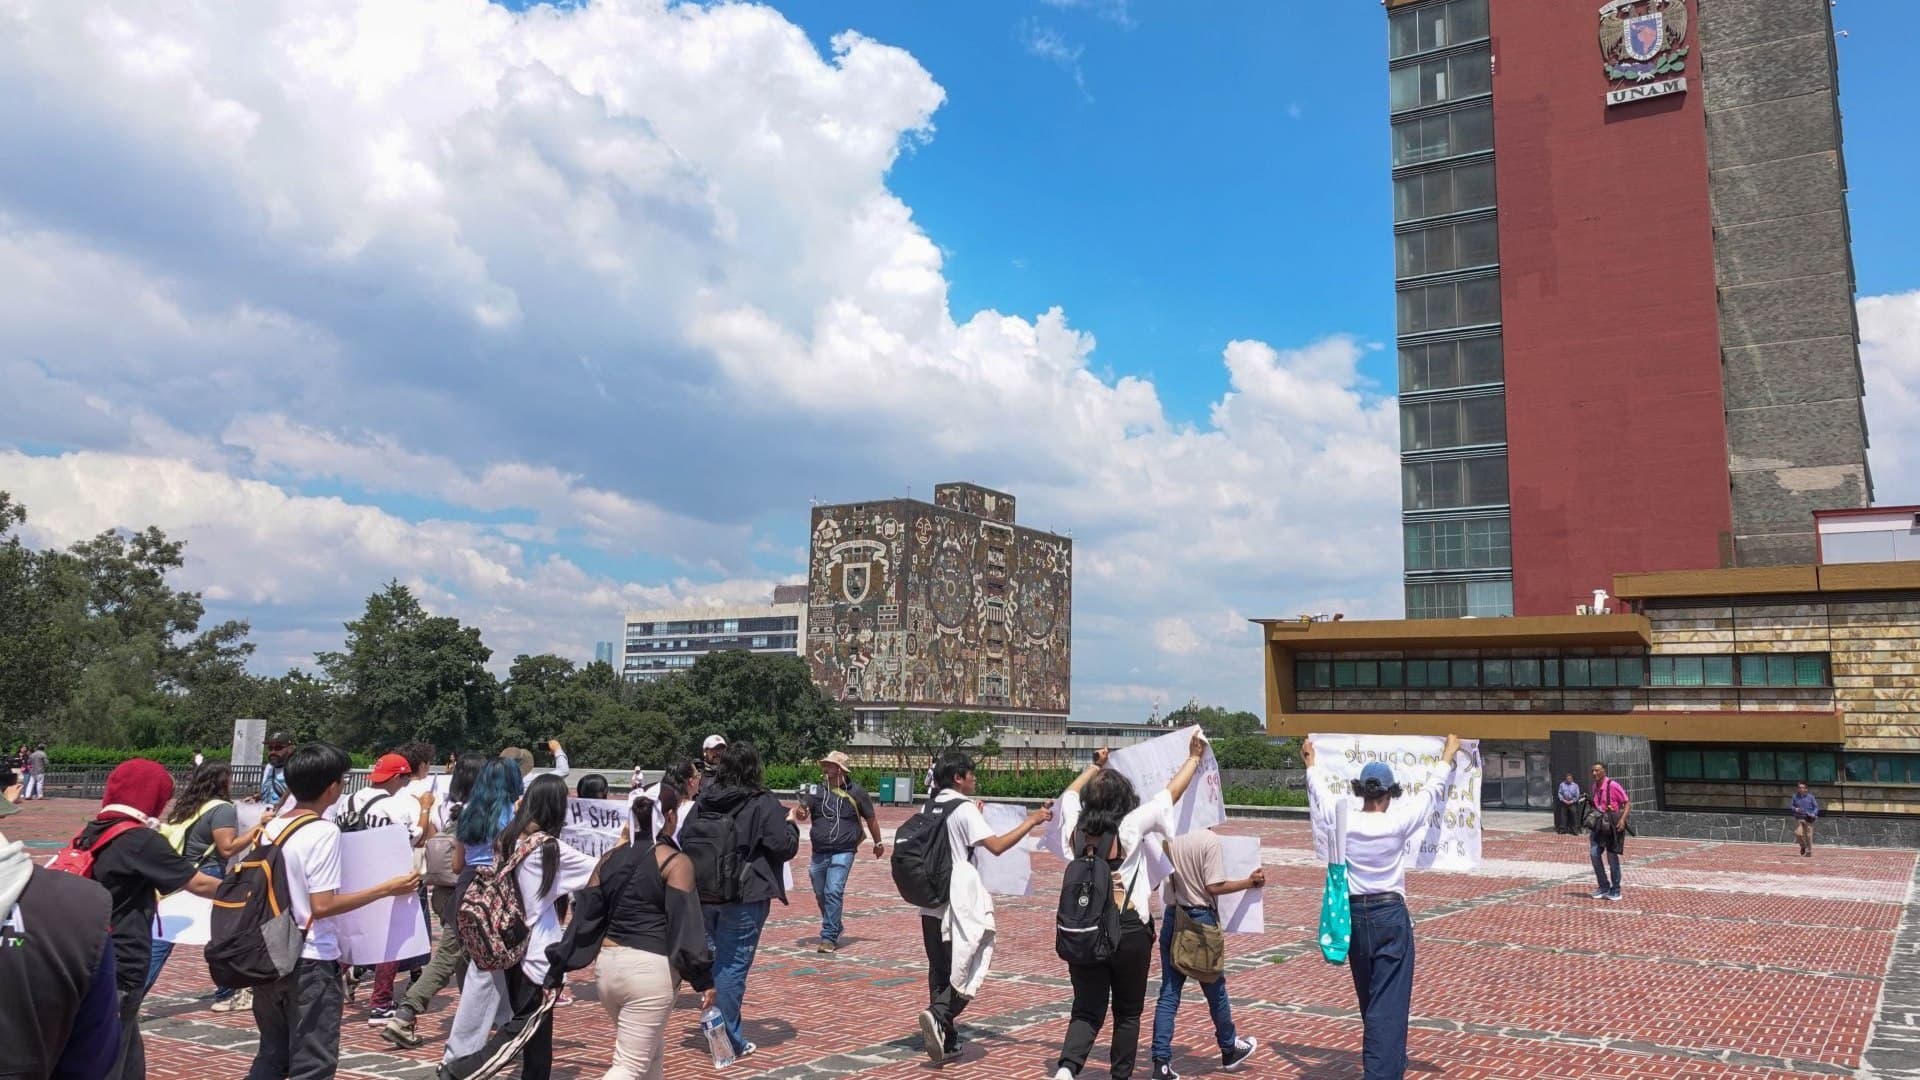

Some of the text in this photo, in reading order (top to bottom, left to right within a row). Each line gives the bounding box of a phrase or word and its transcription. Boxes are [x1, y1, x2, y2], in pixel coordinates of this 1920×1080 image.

[1612, 80, 1680, 102] UNAM
[589, 805, 621, 828] SUR
[8, 938, 24, 947] TV
